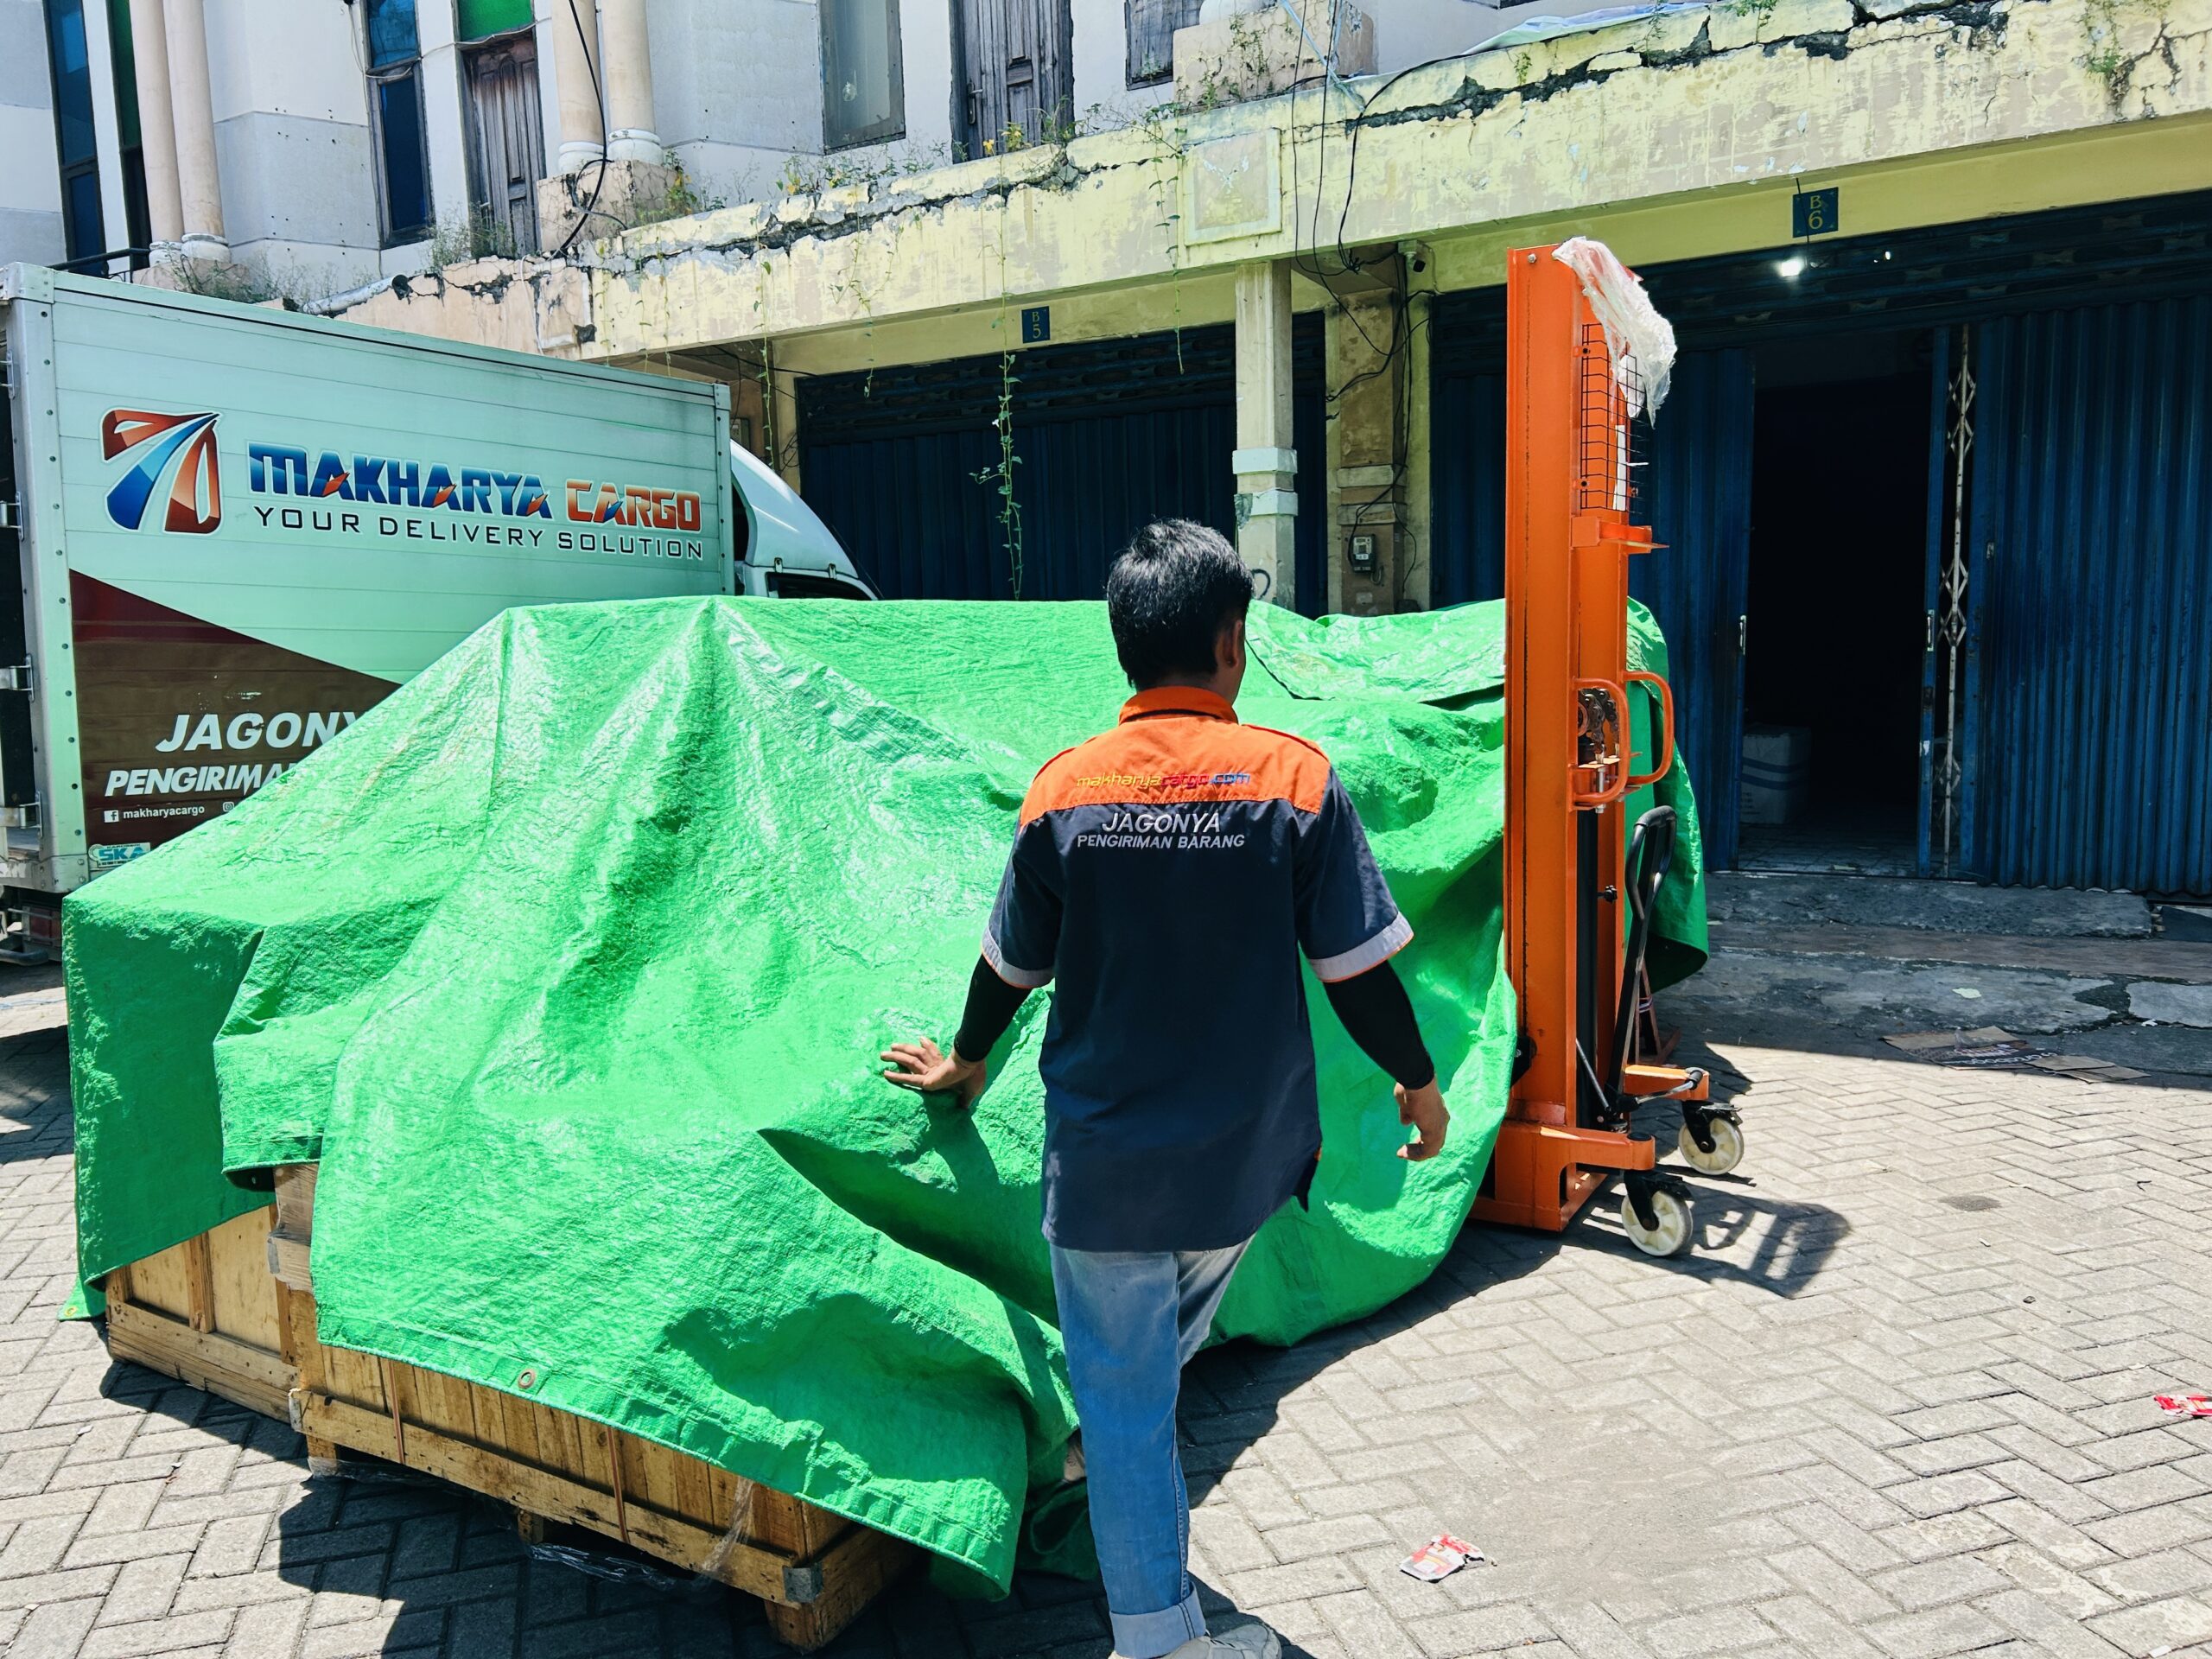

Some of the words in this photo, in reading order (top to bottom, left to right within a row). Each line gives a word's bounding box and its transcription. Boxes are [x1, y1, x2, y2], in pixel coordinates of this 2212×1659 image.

[1810, 195, 1822, 209] B
[1808, 210, 1823, 230] 6
[1032, 311, 1040, 322] B
[1033, 324, 1042, 339] 5
[247, 442, 553, 519] MAKHARYA
[566, 479, 702, 531] CARGO
[253, 505, 360, 533] YOUR
[379, 517, 543, 547] DELIVERY
[558, 531, 702, 559] SOLUTION
[105, 762, 297, 797] PENGIRIMA
[1076, 771, 1250, 790] makharyacargo.com
[123, 804, 206, 819] makharyacargo
[1102, 811, 1221, 834] JAGONYA
[1077, 834, 1173, 849] PENGIRIMAN
[1177, 834, 1245, 849] BARANG
[99, 847, 146, 861] SKA
